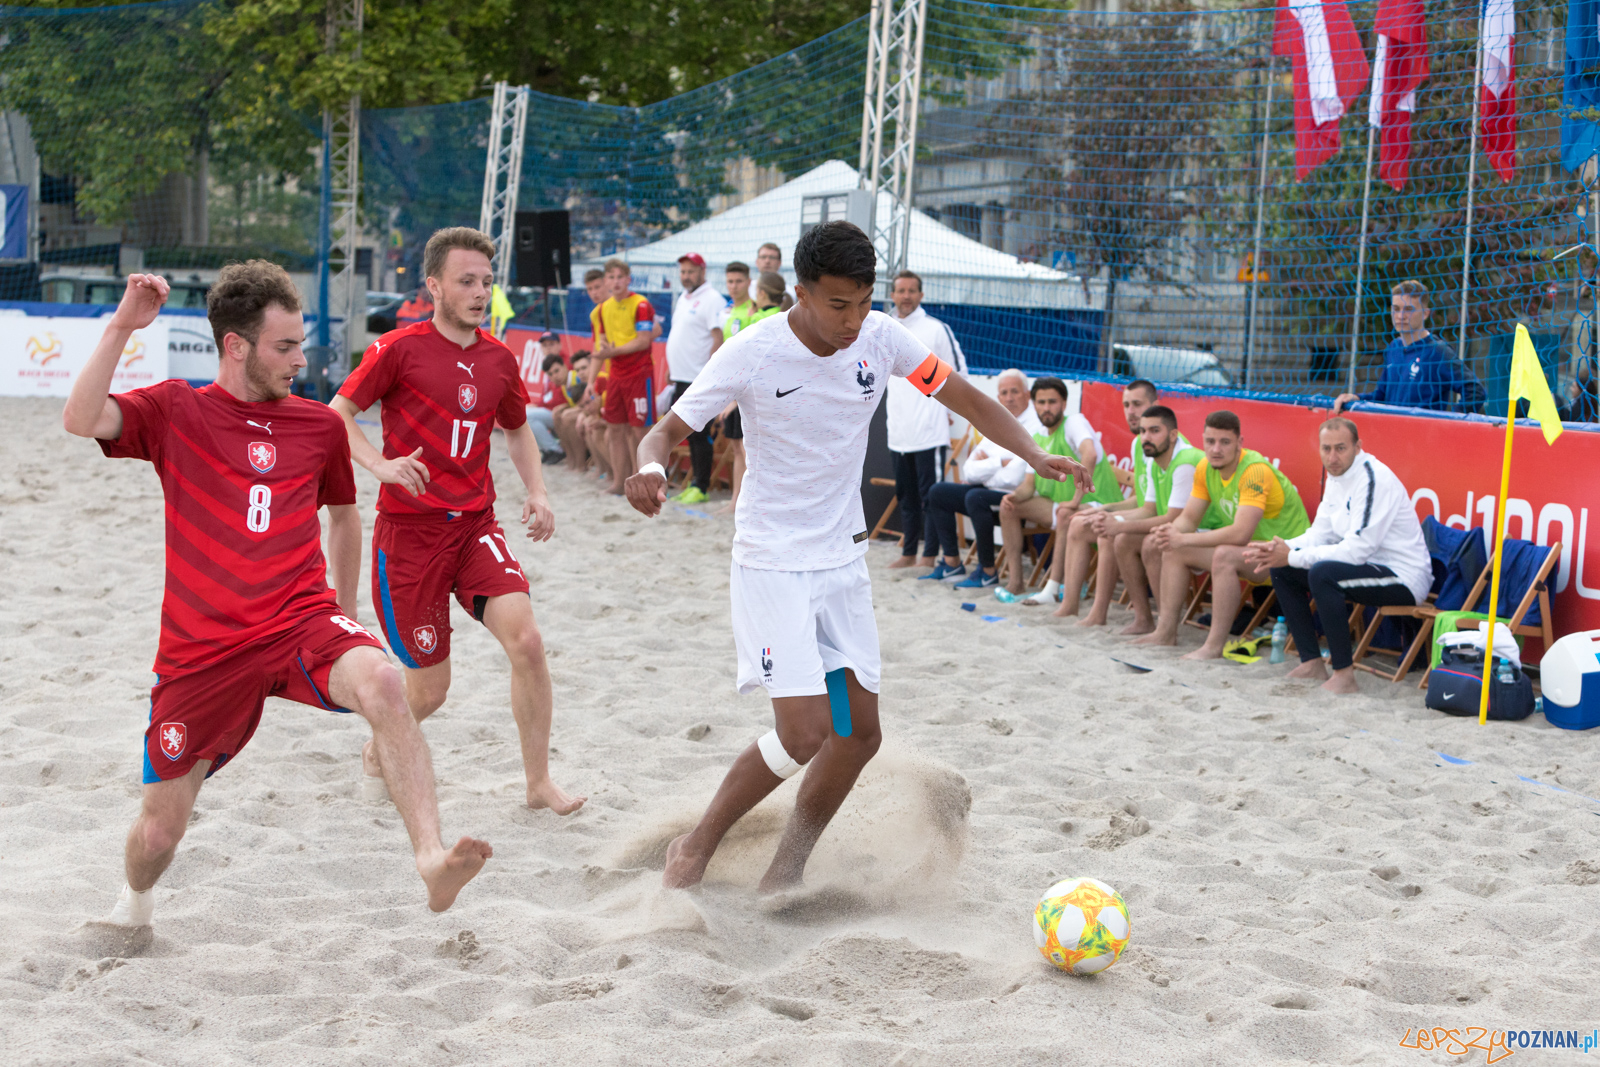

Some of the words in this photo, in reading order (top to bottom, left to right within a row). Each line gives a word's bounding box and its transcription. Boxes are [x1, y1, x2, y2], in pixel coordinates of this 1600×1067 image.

[633, 397, 647, 414] 10
[450, 419, 477, 458] 17
[247, 484, 272, 533] 8
[330, 615, 365, 632] 8
